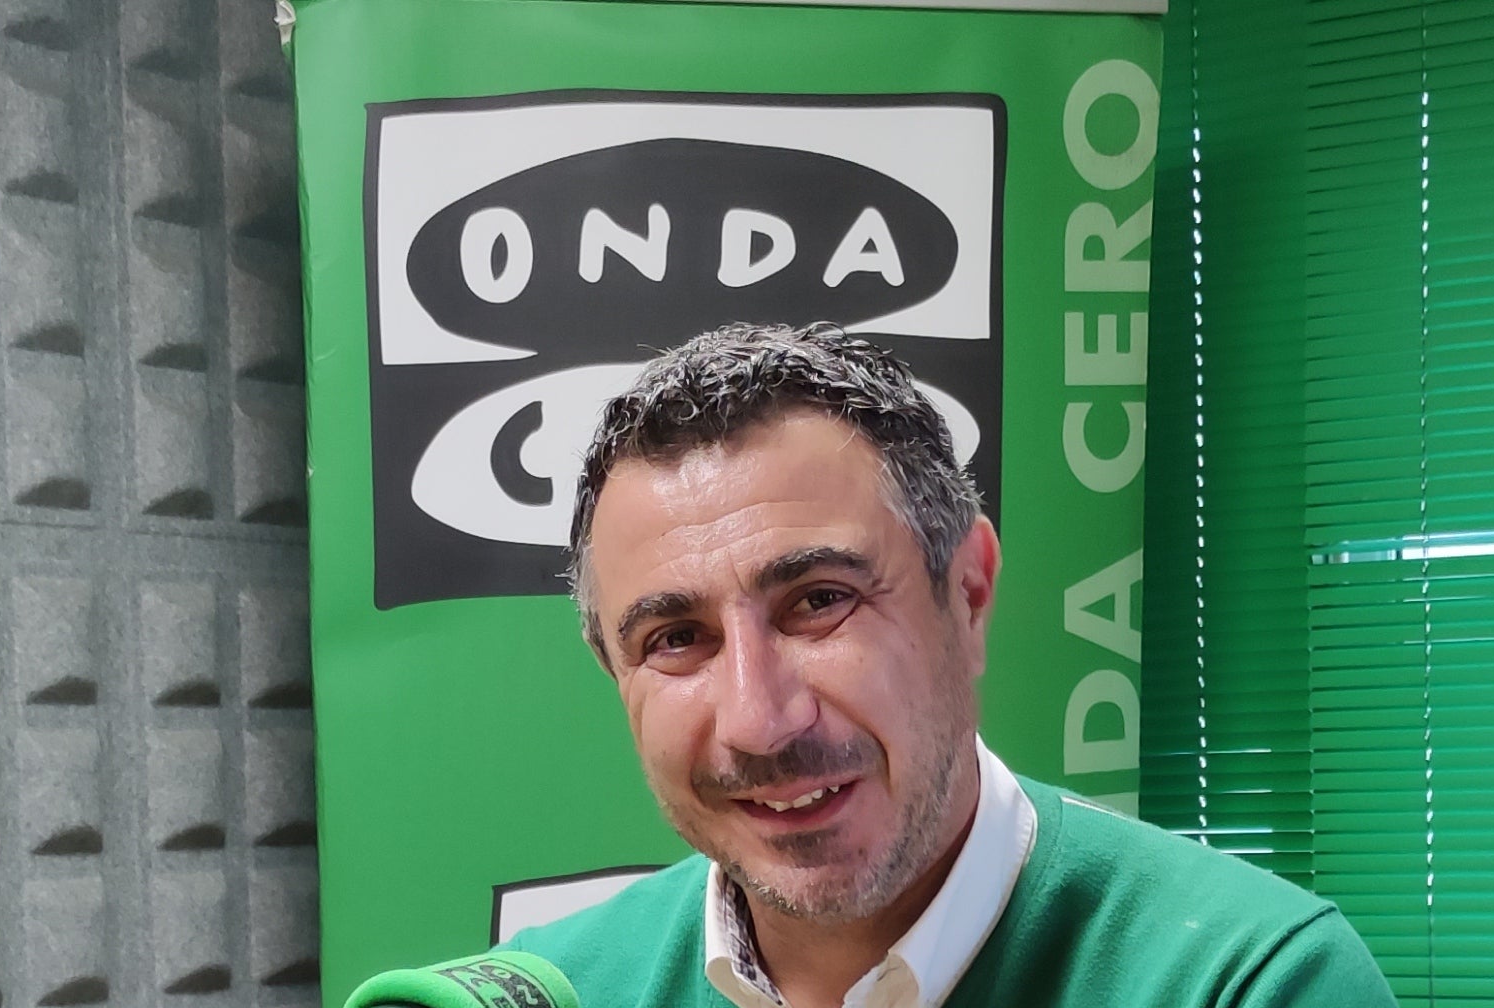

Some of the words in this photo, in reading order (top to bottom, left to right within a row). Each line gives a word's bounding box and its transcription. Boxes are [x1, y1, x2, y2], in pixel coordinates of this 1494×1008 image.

[460, 203, 905, 304] ONDA
[1062, 59, 1161, 494] CERO
[1063, 548, 1144, 819] DA
